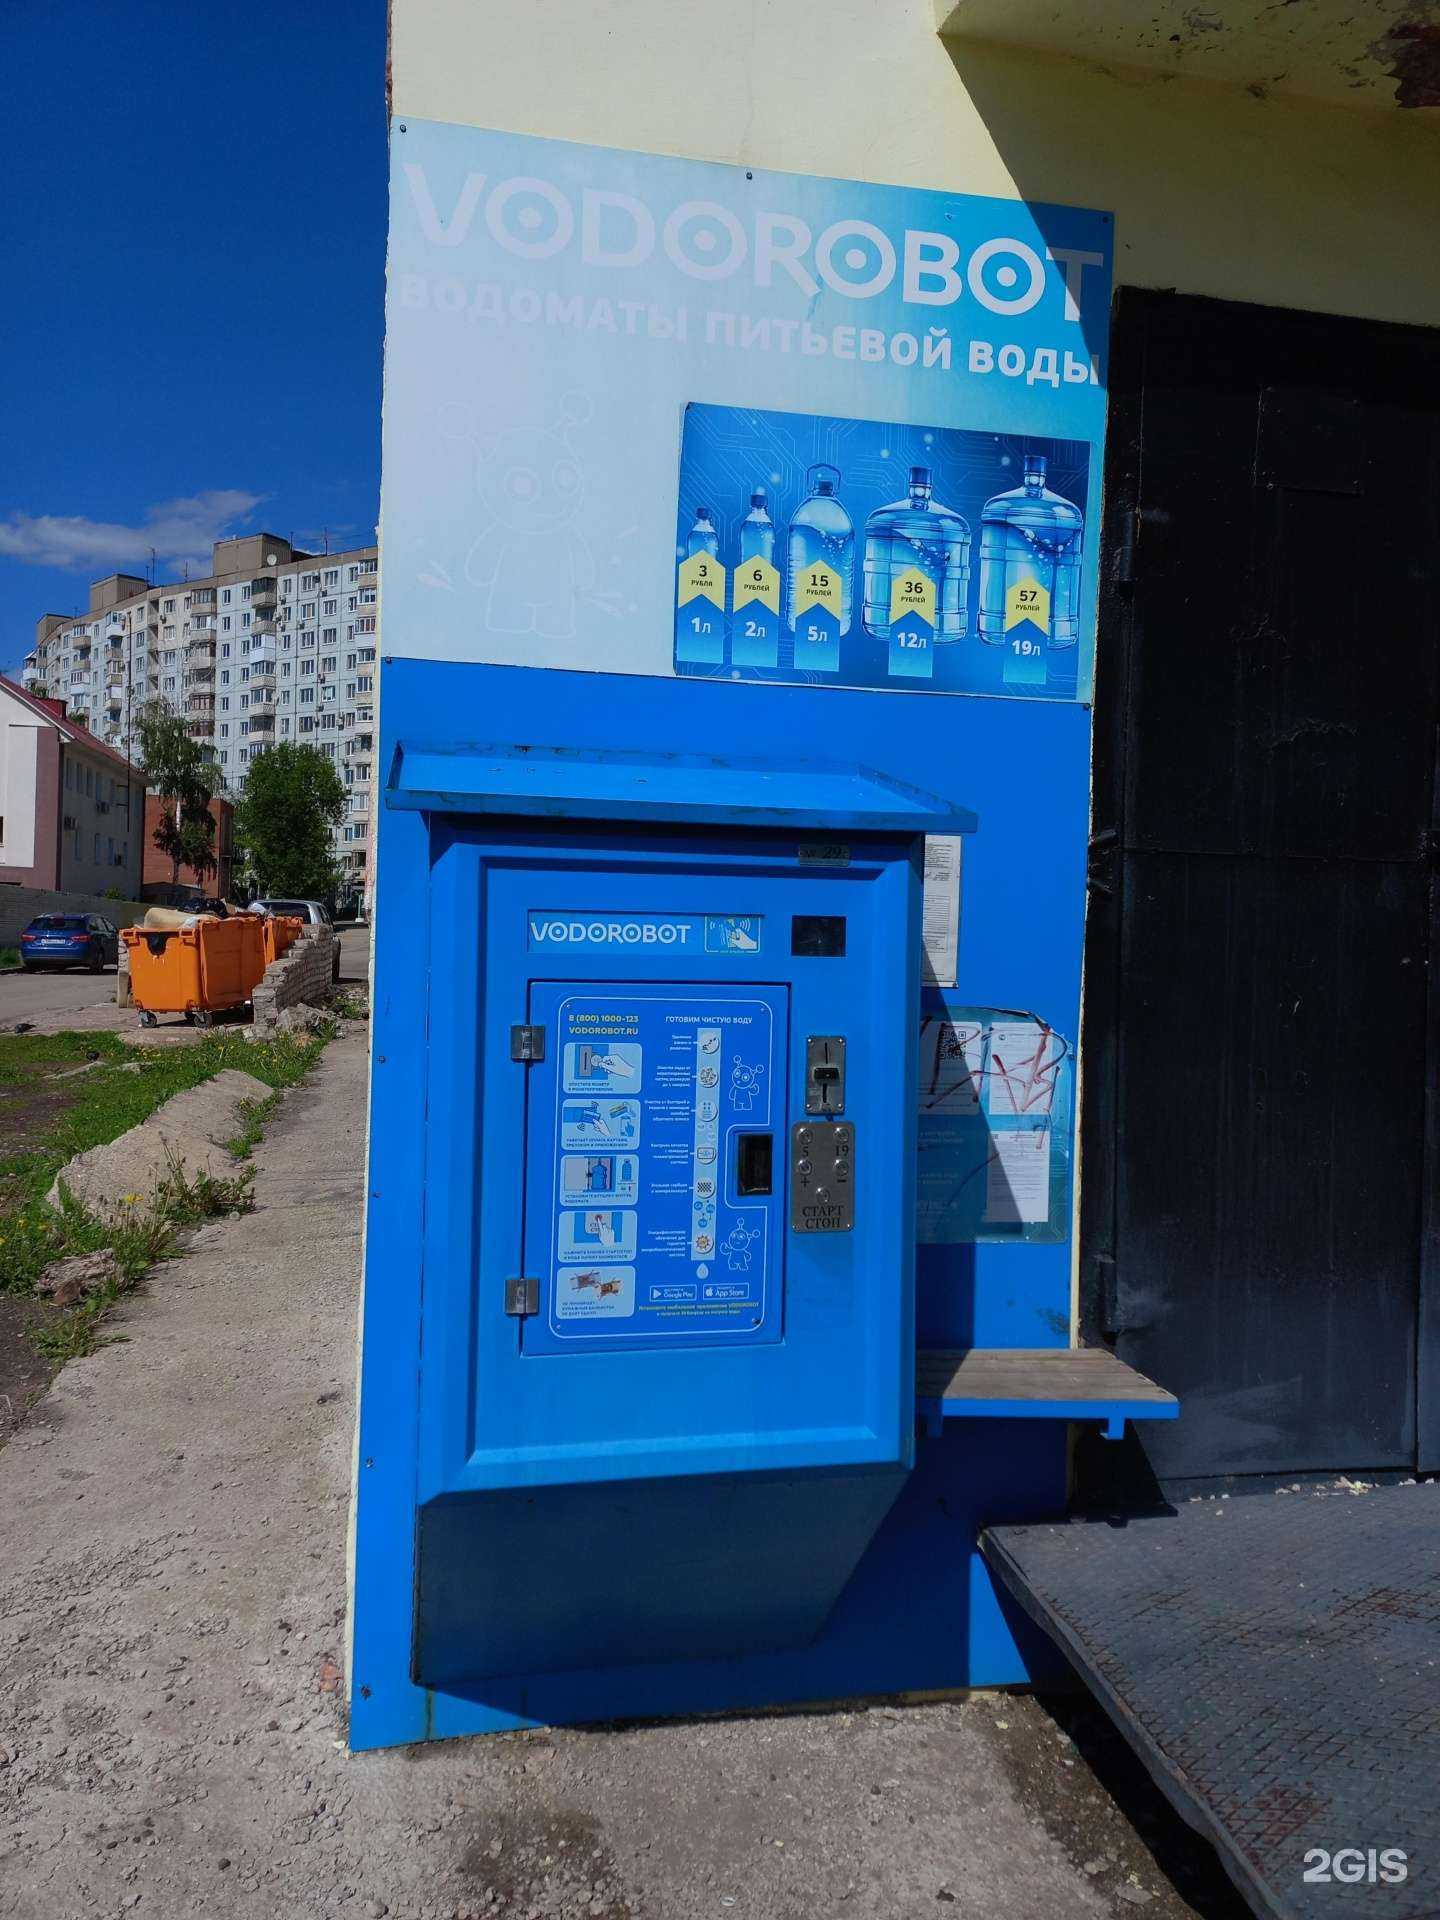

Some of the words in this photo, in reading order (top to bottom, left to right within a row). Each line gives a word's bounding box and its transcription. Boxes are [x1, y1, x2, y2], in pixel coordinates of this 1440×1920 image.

[403, 162, 1104, 322] VODOROBOT
[401, 272, 687, 342] ВОДОМАТЫ
[705, 310, 952, 370] ПИТЬЕВОЙ
[968, 338, 1100, 388] ВОДЫ
[698, 564, 708, 578] 3
[753, 569, 763, 582] 6
[810, 574, 829, 588] 15
[904, 581, 923, 595] 36
[1019, 590, 1037, 603] 57
[530, 921, 692, 944] VODOROBOT
[568, 1026, 639, 1036] VODOROBOT.RU
[836, 1145, 850, 1157] 19
[802, 1205, 844, 1218] СТАРТ
